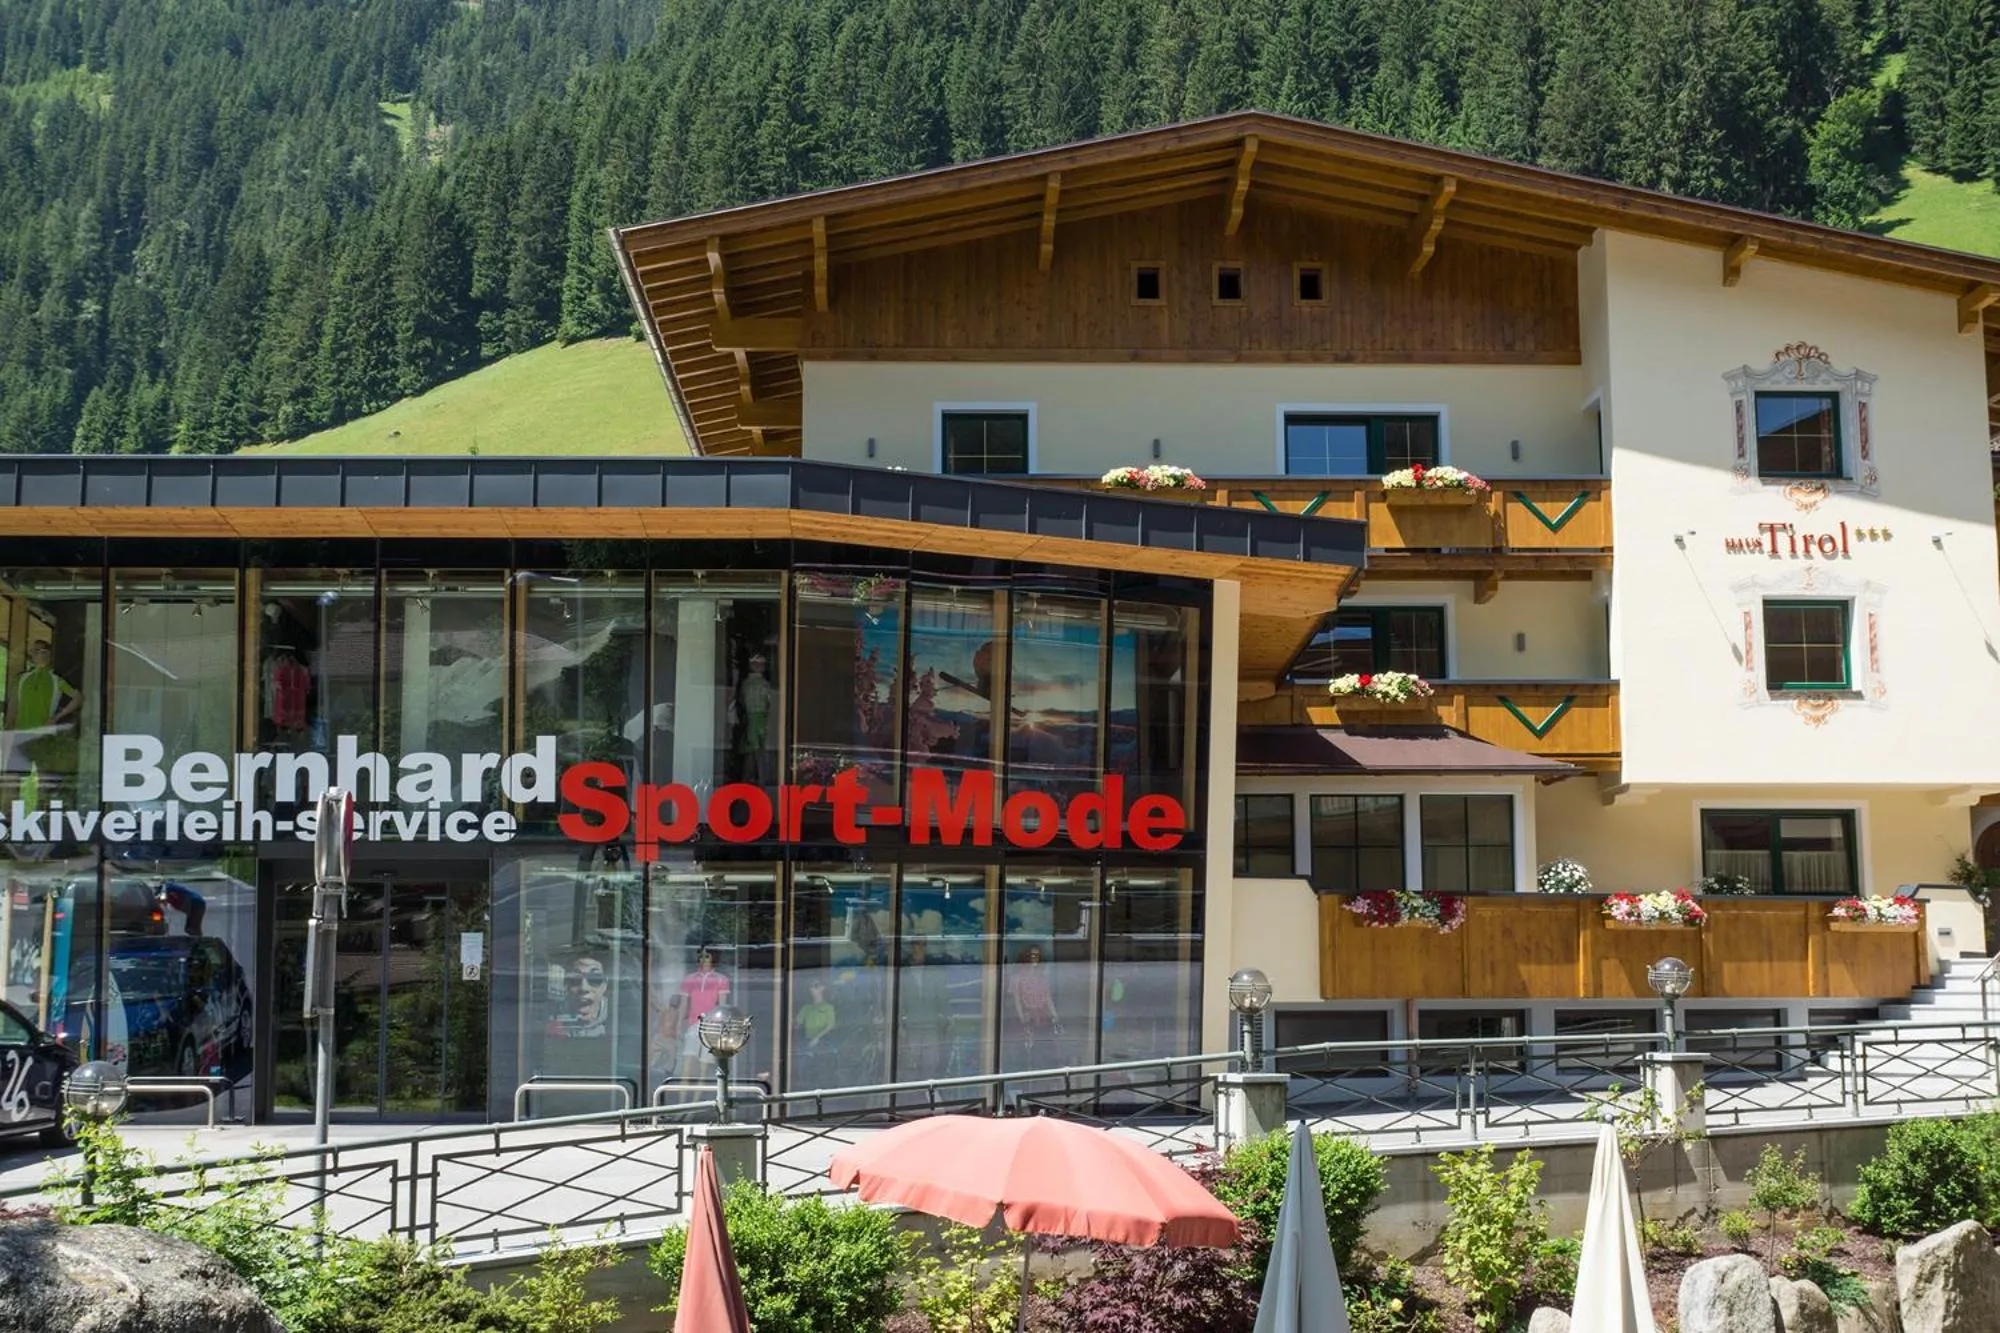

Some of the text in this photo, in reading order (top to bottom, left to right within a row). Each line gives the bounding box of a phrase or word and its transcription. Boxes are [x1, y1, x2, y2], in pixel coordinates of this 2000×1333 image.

[1758, 521, 1851, 558] Tirol
[102, 734, 1186, 862] Bernhard Sport-Mode
[0, 800, 517, 842] kiverleih-srvice
